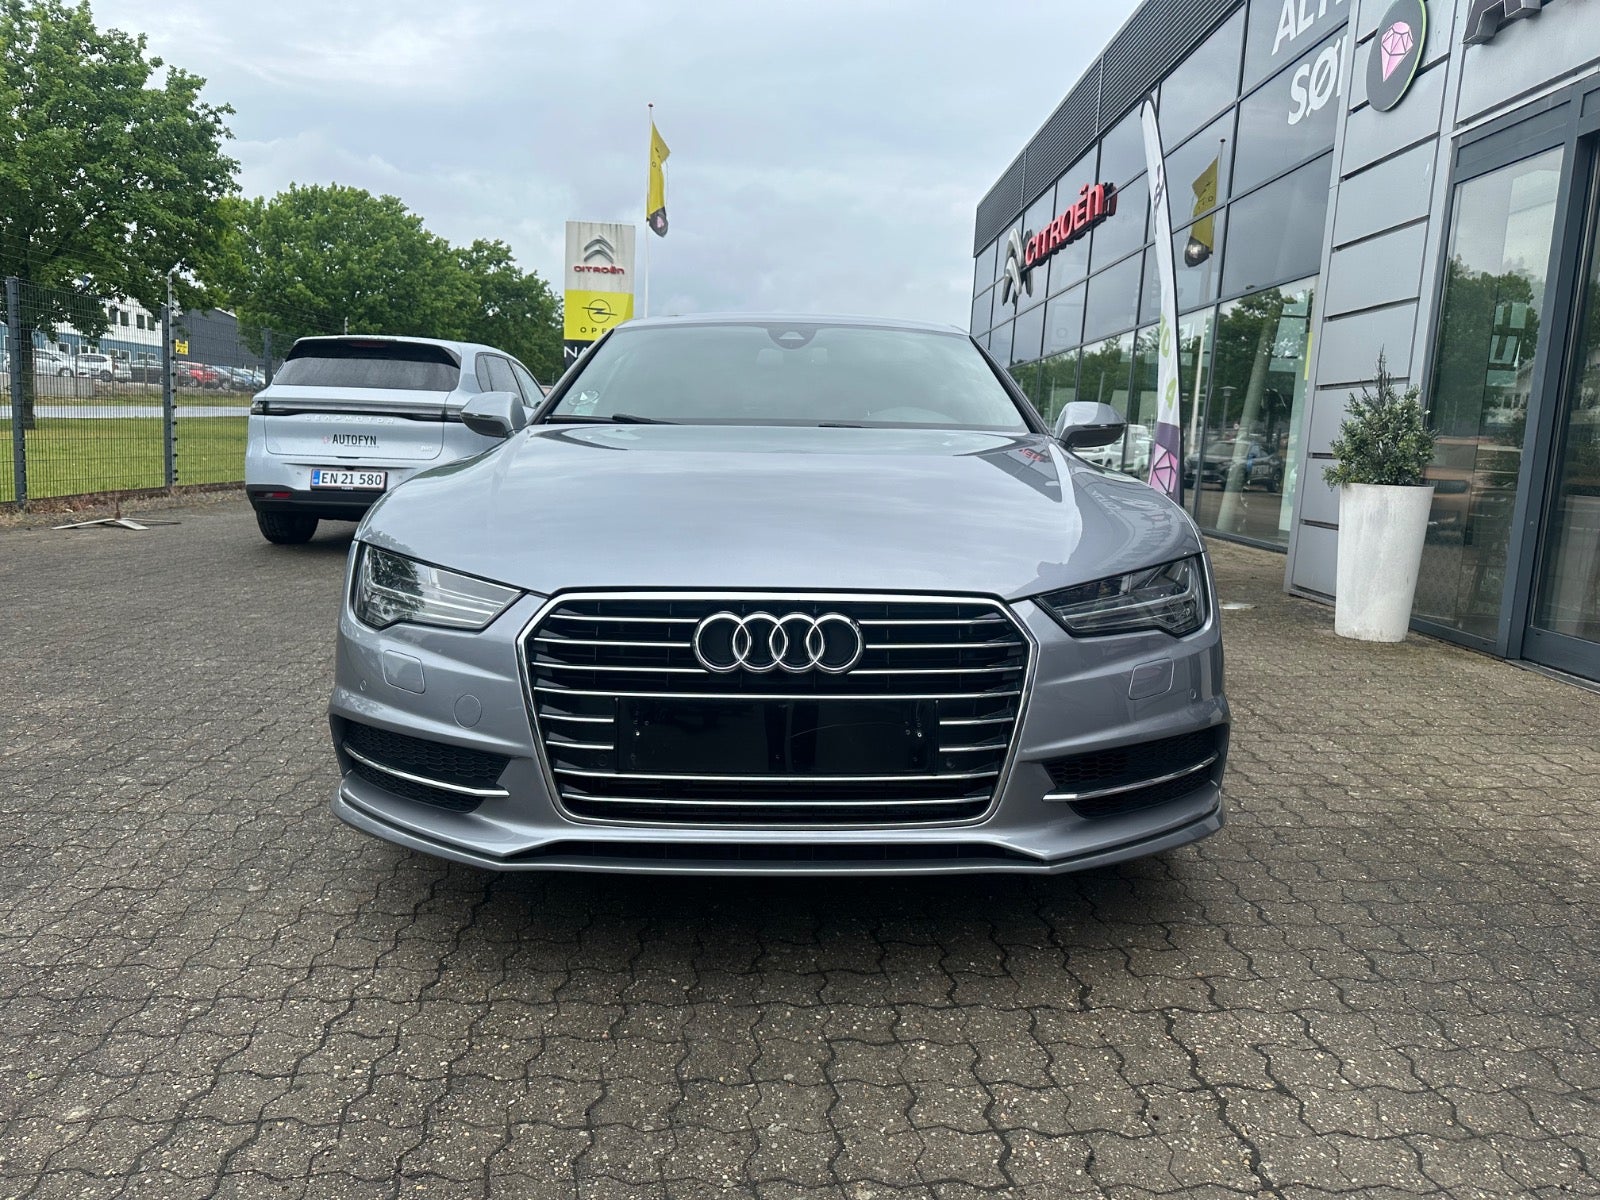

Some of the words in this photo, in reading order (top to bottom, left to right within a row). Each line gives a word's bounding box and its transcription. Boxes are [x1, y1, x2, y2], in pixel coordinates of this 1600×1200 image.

[580, 326, 607, 334] OPE
[332, 433, 377, 445] AUTOFYN
[321, 472, 338, 484] EN
[340, 473, 354, 485] 21
[358, 473, 382, 486] 580
